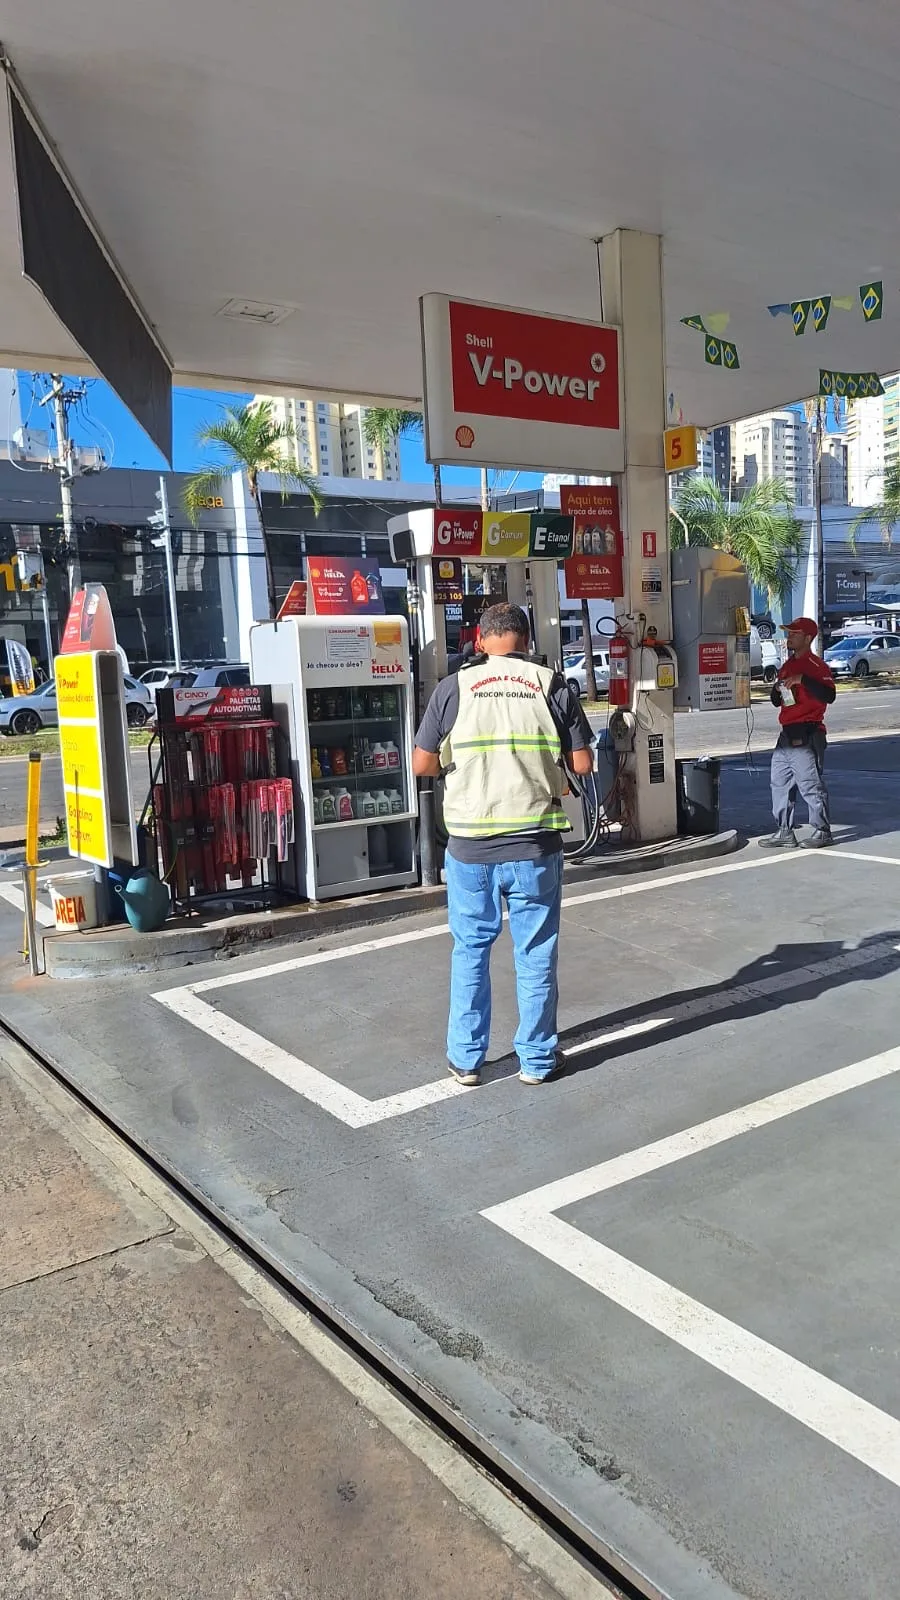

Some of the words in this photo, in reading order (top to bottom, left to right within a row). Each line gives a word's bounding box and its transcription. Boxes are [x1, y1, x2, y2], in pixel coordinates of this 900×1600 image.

[466, 333, 493, 349] Shell
[468, 352, 600, 401] V-Power
[671, 436, 682, 460] 5
[194, 496, 224, 509] aga
[567, 493, 591, 507] Aqui
[593, 496, 612, 505] tem
[587, 507, 596, 515] de
[598, 507, 613, 515] óleo
[437, 521, 452, 545] G
[453, 527, 475, 539] V-Power
[487, 522, 500, 546] G
[534, 527, 547, 551] E
[547, 532, 570, 542] Etanol
[590, 567, 611, 575] HELIX
[836, 580, 860, 589] T-Cross
[316, 661, 339, 669] checou
[346, 660, 363, 668] óleo?
[371, 663, 405, 674] HELIX
[511, 675, 541, 693] CÁLCULO
[506, 691, 536, 699] GOIÂNIA
[214, 704, 261, 713] AUTOMOTIVAS
[54, 896, 87, 924] AREIA
